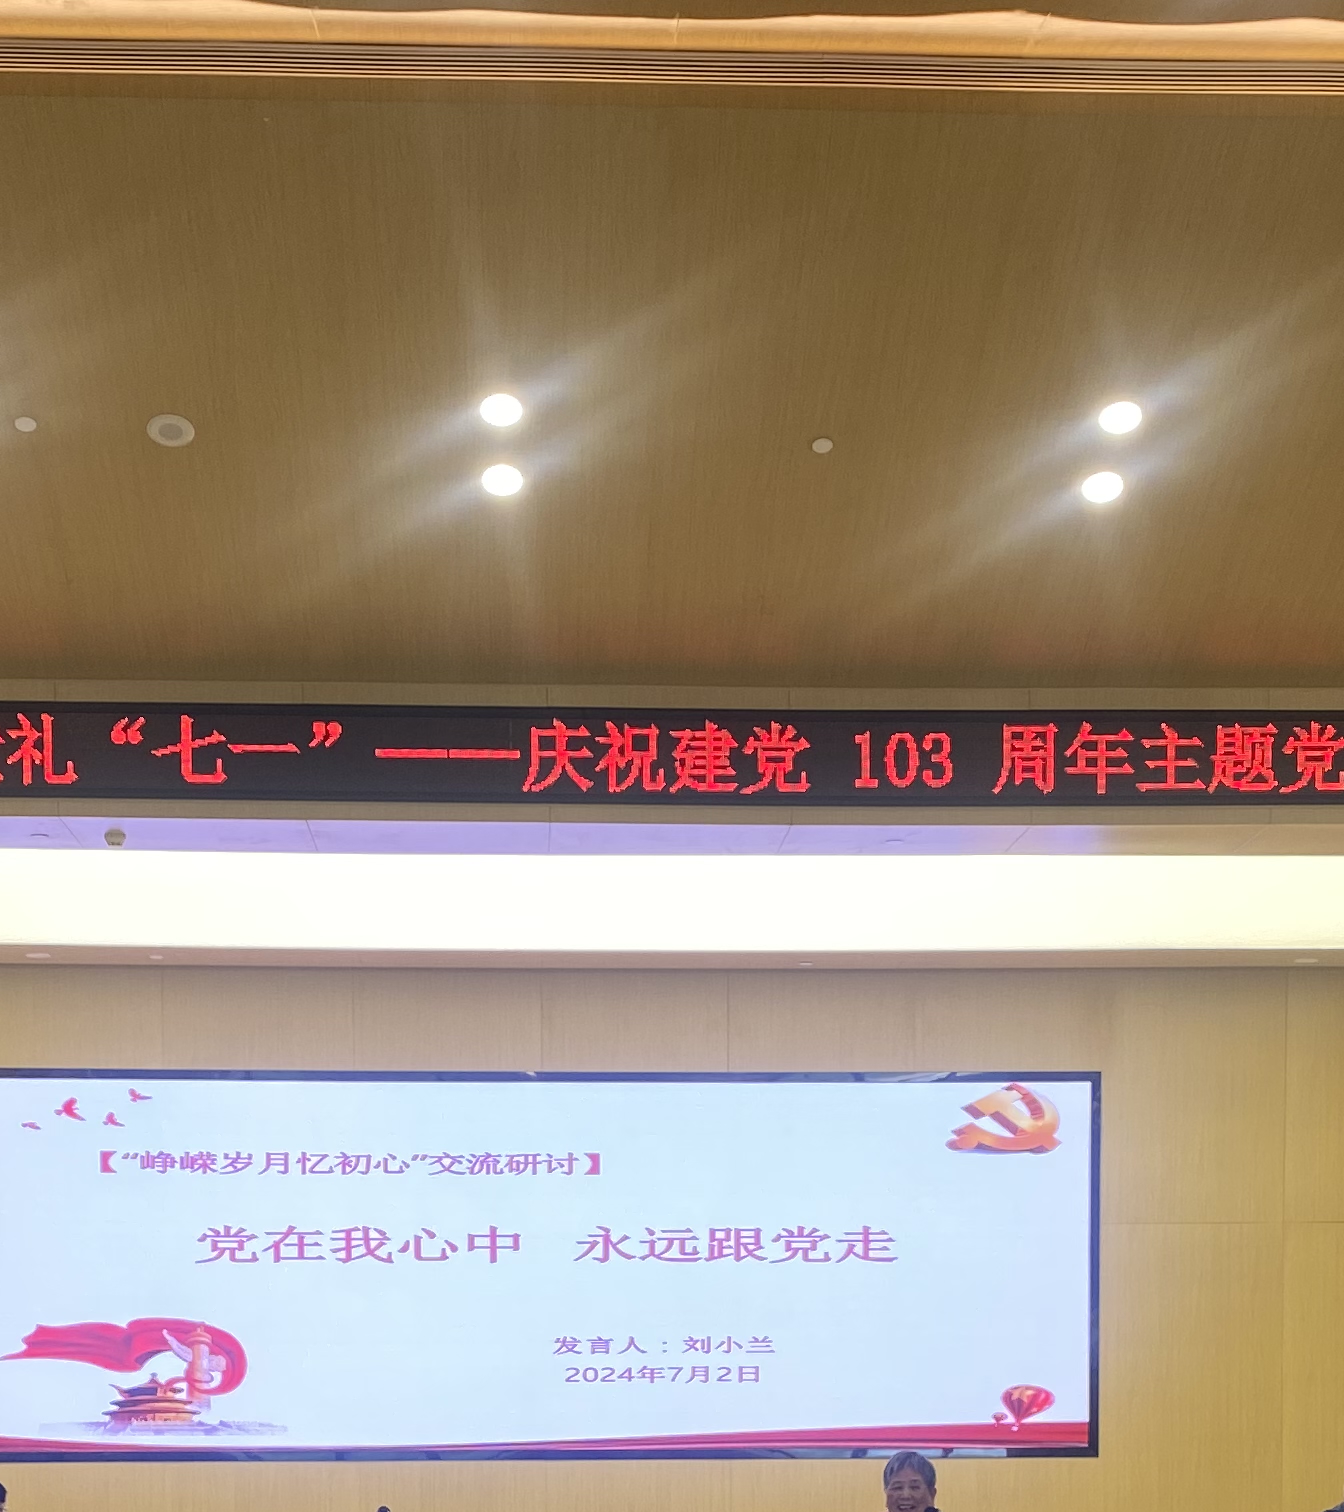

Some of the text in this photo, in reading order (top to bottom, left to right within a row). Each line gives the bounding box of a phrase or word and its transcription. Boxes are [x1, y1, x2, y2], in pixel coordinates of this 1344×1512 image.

[854, 731, 954, 791] 103
[194, 1224, 899, 1264] 党在我心中 永远跟党走
[564, 1365, 760, 1384] 2024年7月2日
